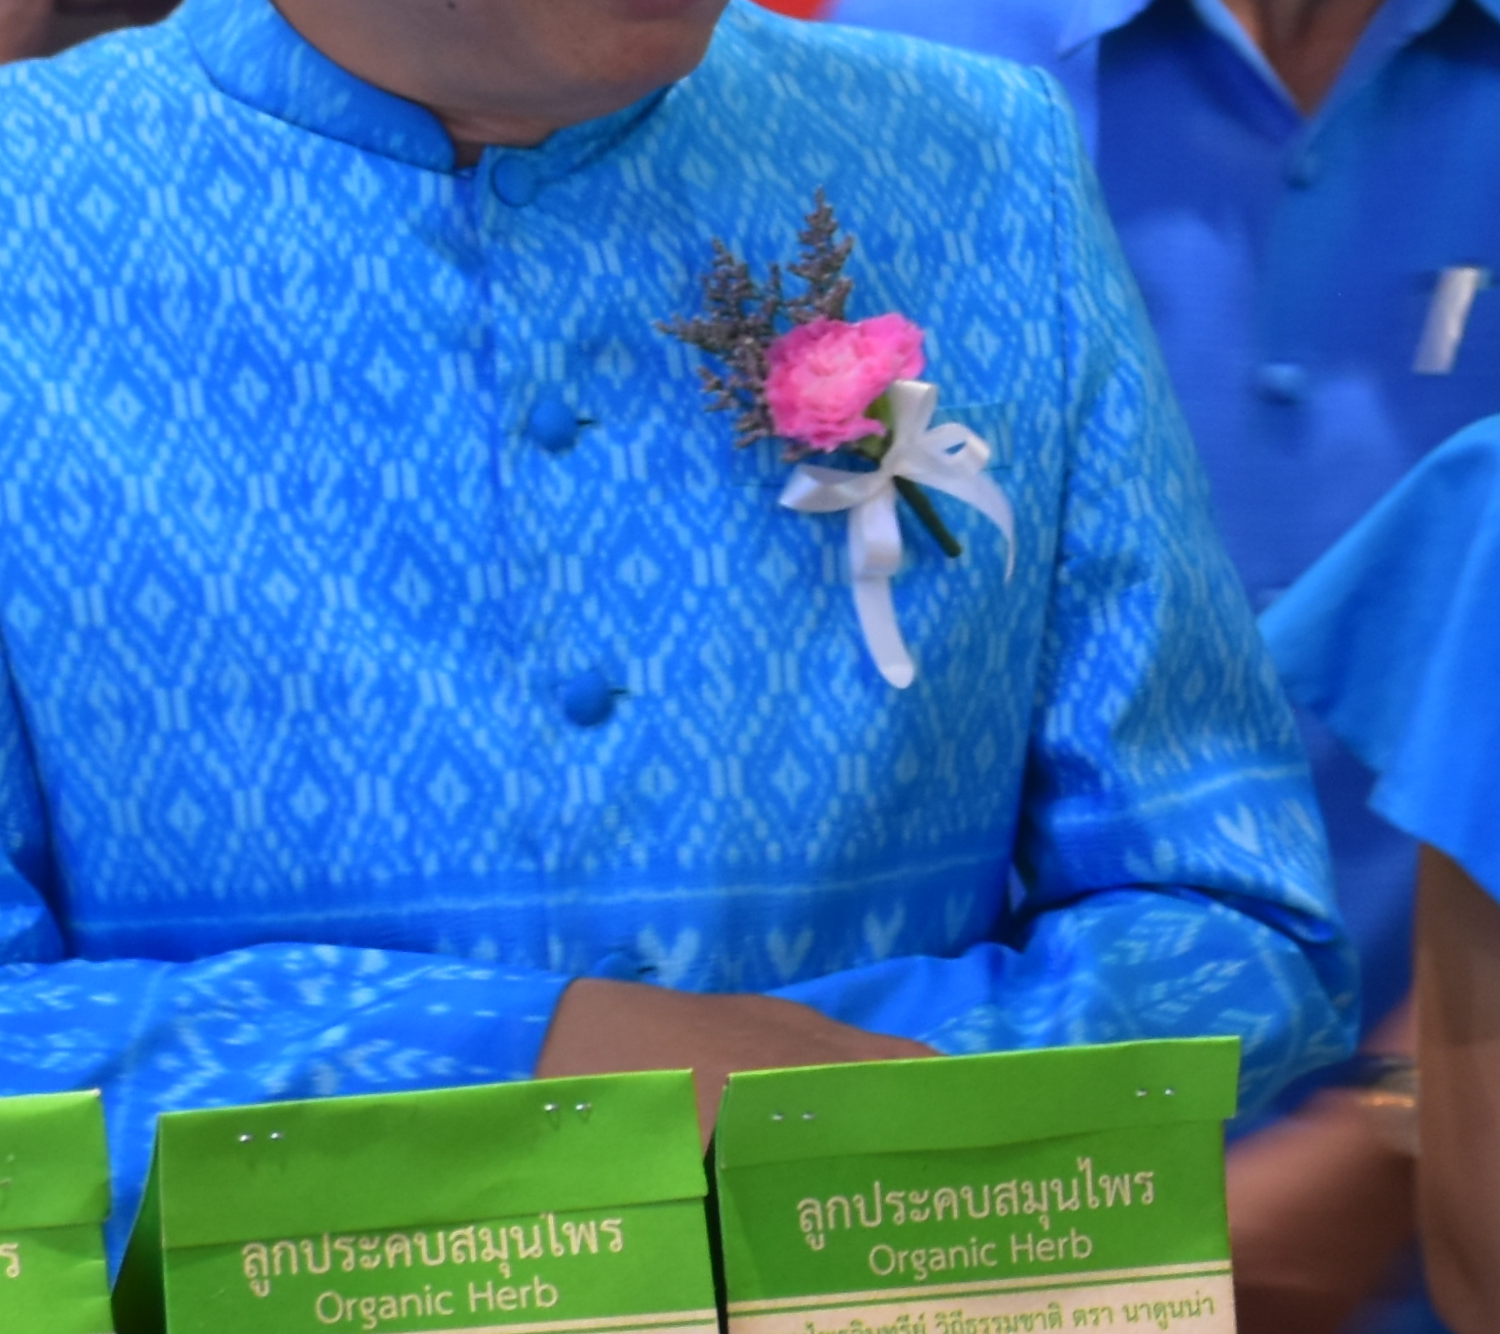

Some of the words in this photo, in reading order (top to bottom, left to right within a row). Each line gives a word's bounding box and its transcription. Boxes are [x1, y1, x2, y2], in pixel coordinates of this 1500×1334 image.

[796, 1157, 1155, 1251] ลูกประคบสมุนไพร
[241, 1213, 624, 1297] ลูกประคบสมุนไพร
[868, 1238, 997, 1280] Organic
[1010, 1228, 1093, 1264] Herb
[315, 1286, 454, 1329] Organic
[469, 1276, 558, 1312] Herb
[1072, 1304, 1114, 1326] ตรา
